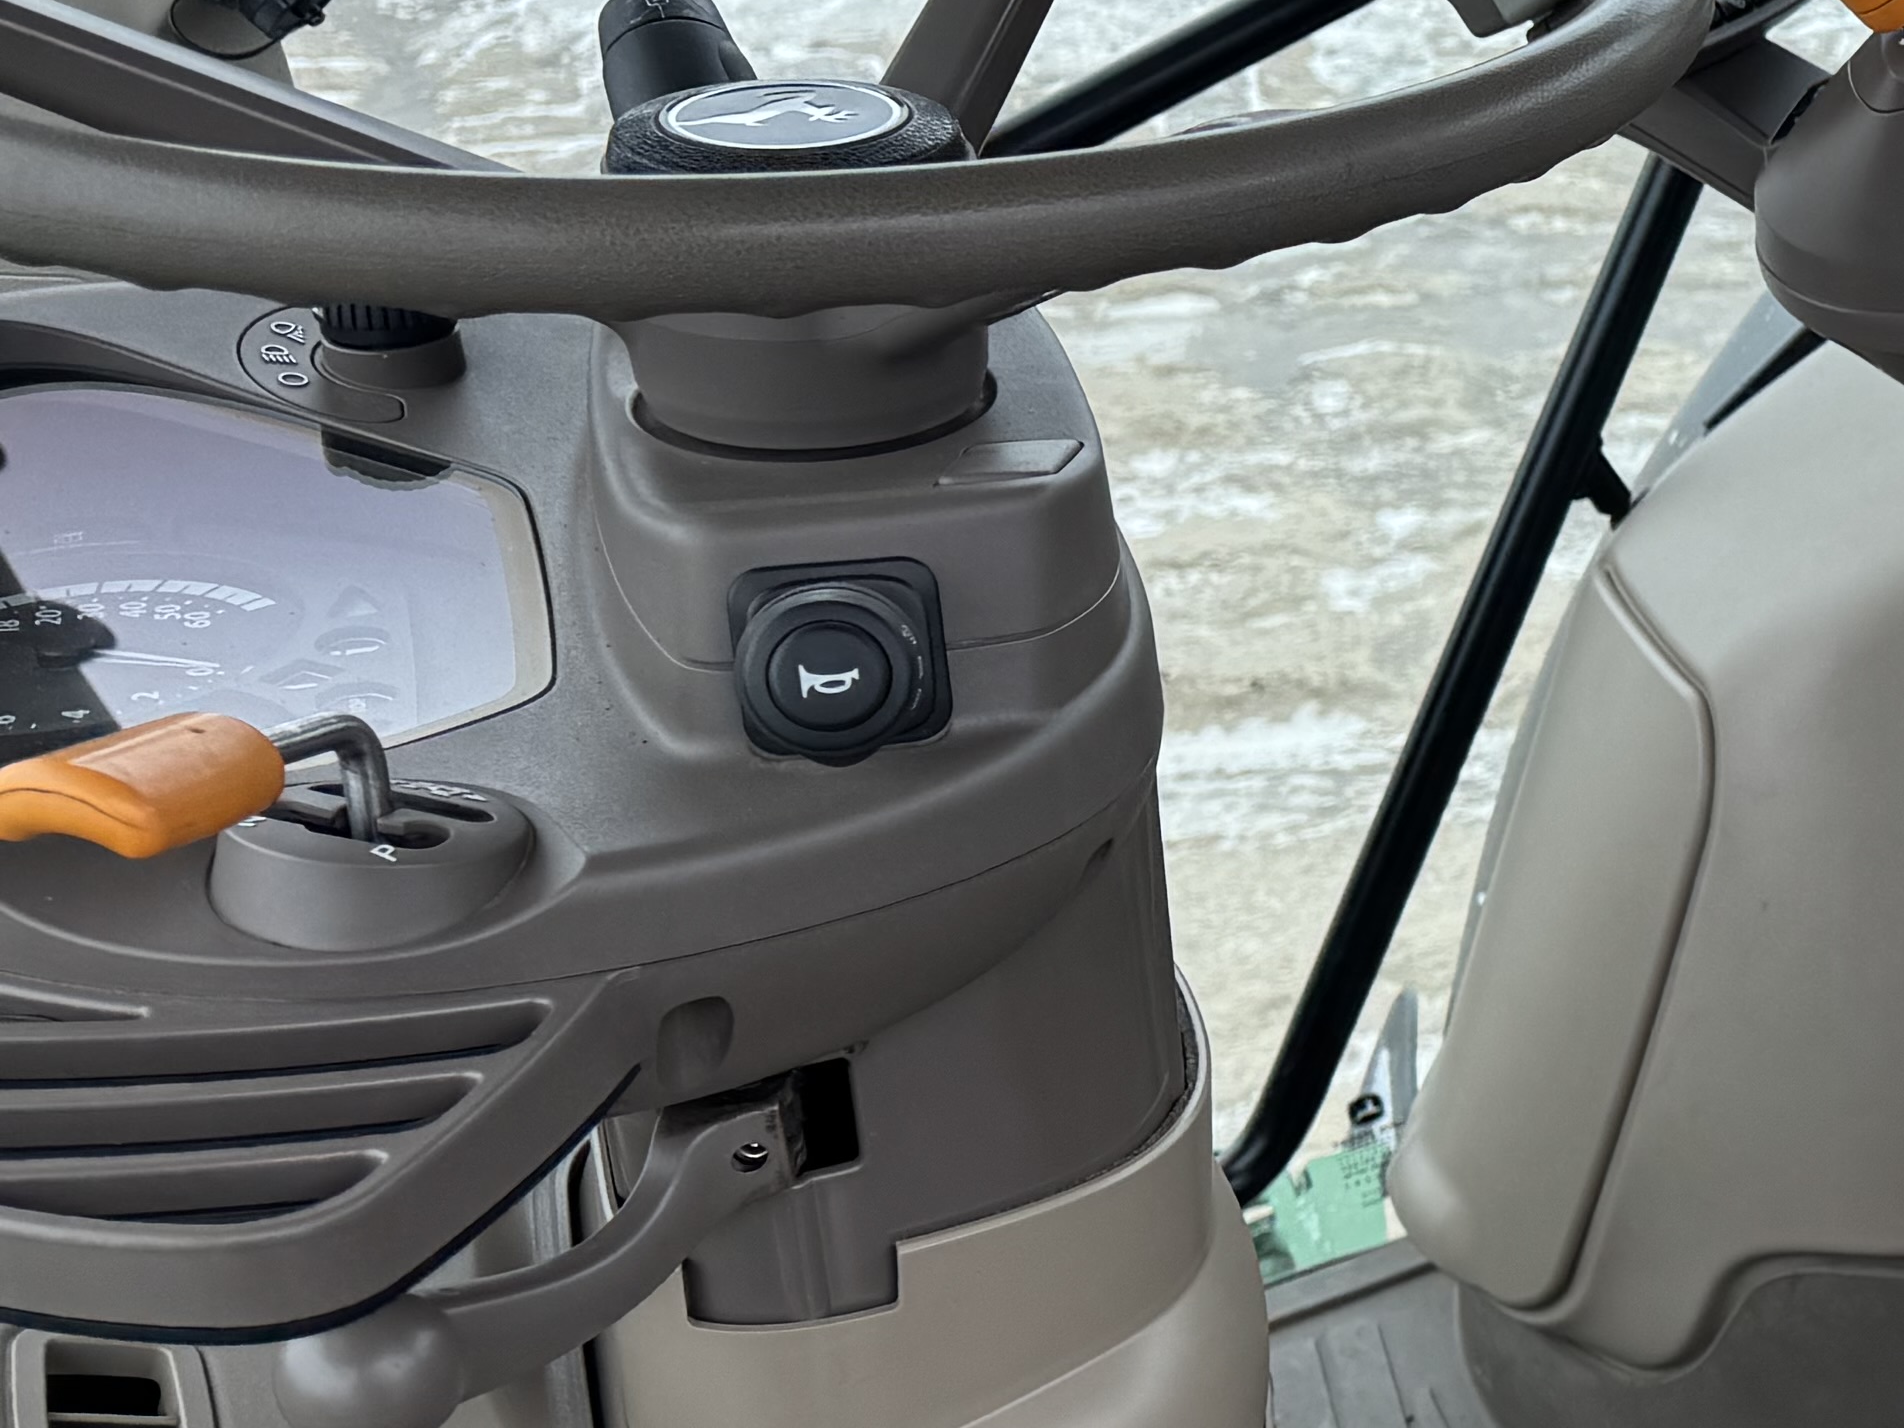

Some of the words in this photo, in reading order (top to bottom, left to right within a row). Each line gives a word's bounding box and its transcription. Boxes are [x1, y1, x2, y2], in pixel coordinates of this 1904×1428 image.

[35, 609, 62, 625] 20
[77, 603, 105, 620] 30
[119, 601, 147, 618] 40
[154, 604, 181, 620] 50
[183, 611, 211, 628] 60
[185, 667, 215, 677] 0
[131, 691, 160, 701] 2
[61, 709, 90, 719] 4
[369, 843, 398, 863] P
